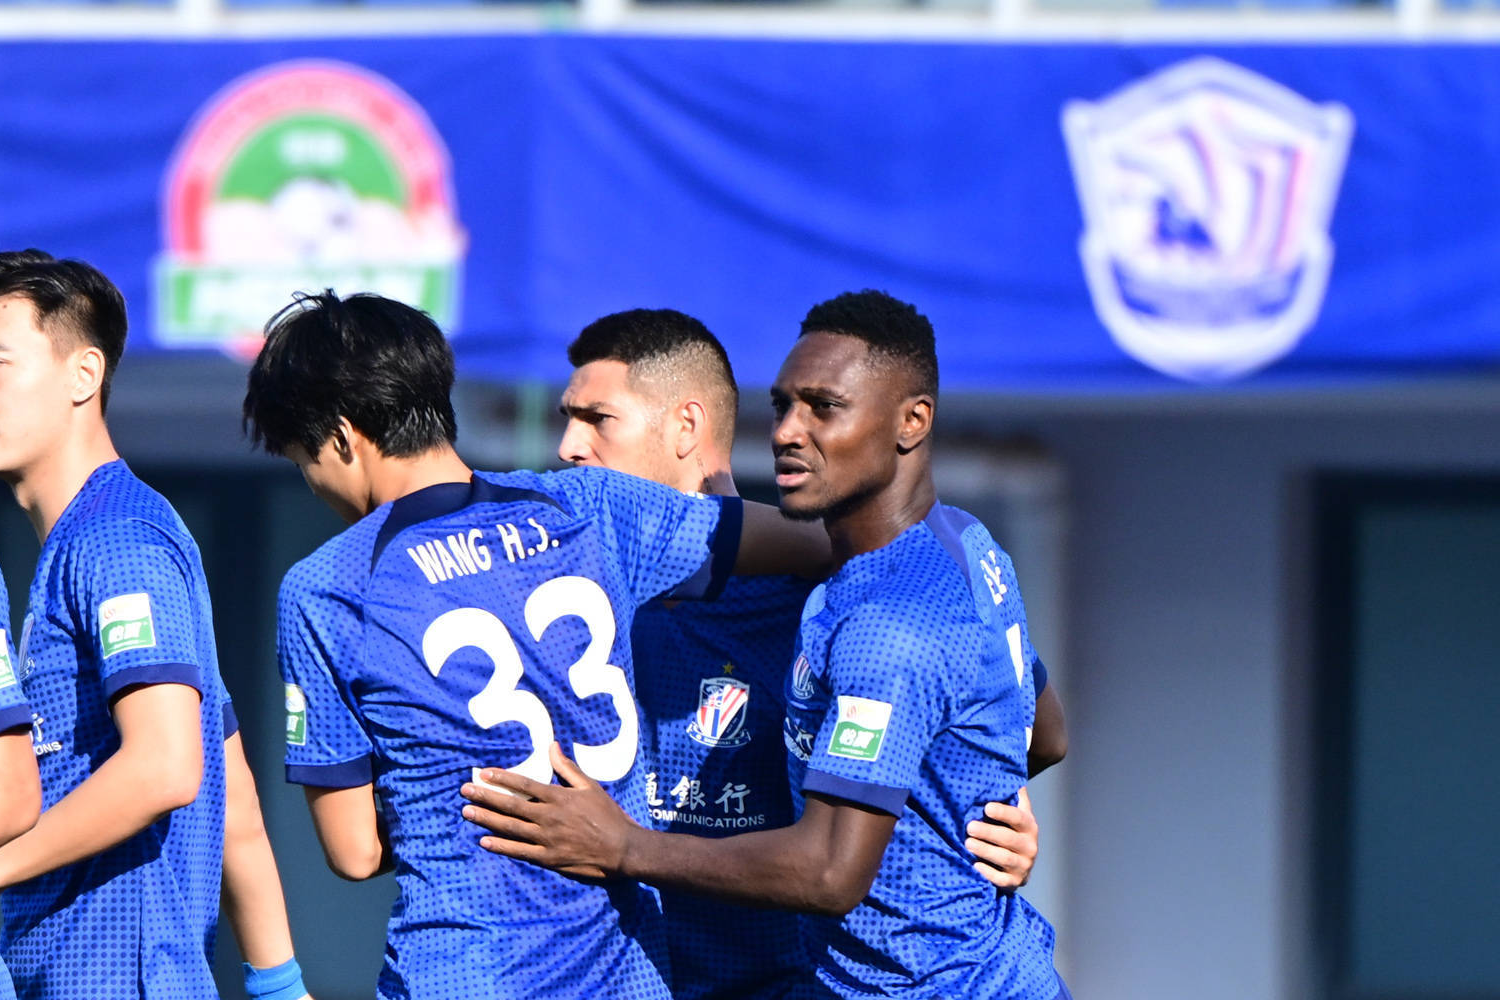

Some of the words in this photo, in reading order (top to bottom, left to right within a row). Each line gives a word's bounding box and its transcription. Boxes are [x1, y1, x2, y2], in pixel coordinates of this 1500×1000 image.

[406, 528, 492, 585] WANG
[496, 517, 560, 563] H.J.
[422, 575, 639, 801] 33
